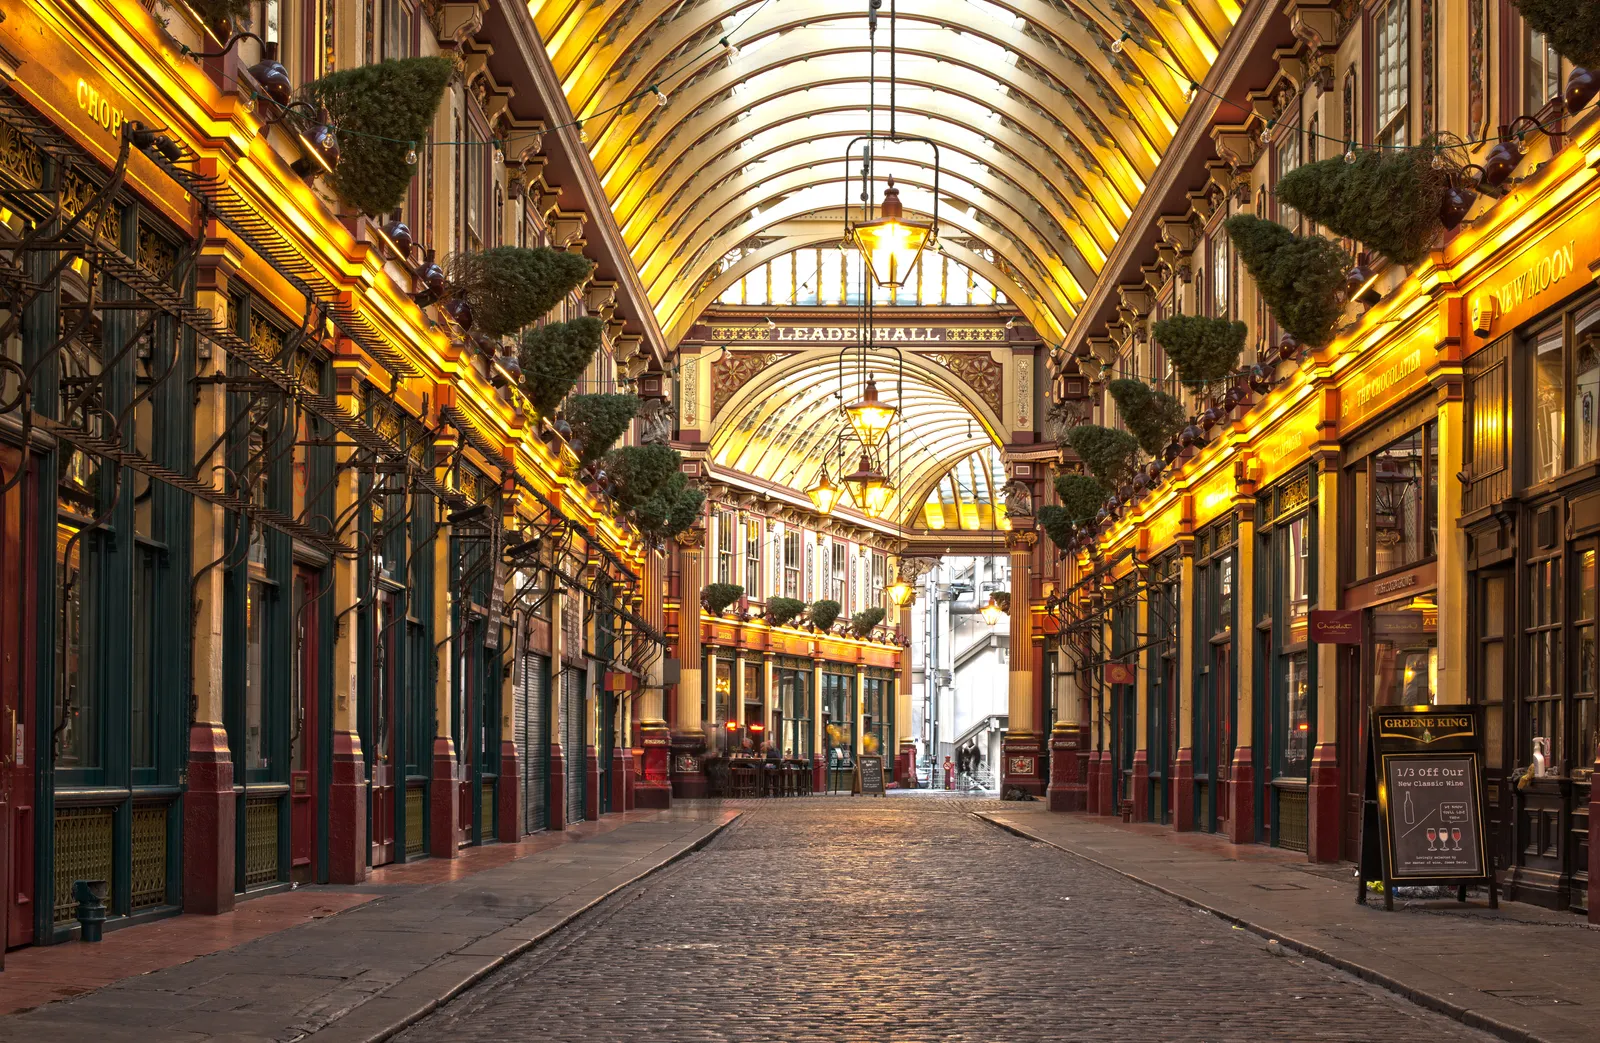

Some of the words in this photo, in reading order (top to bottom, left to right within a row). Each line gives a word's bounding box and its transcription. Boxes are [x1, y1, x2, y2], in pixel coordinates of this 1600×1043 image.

[1495, 272, 1527, 320] NEW
[1528, 240, 1575, 300] MOON
[777, 327, 941, 341] LEADENHALL
[1356, 383, 1371, 407] THE
[1371, 349, 1421, 398] CHOCOLATIER
[1384, 717, 1434, 728] GREENE
[1437, 717, 1468, 727] KING
[1397, 768, 1415, 777] 1/3
[1418, 768, 1439, 777] Off
[1442, 768, 1464, 777] Our
